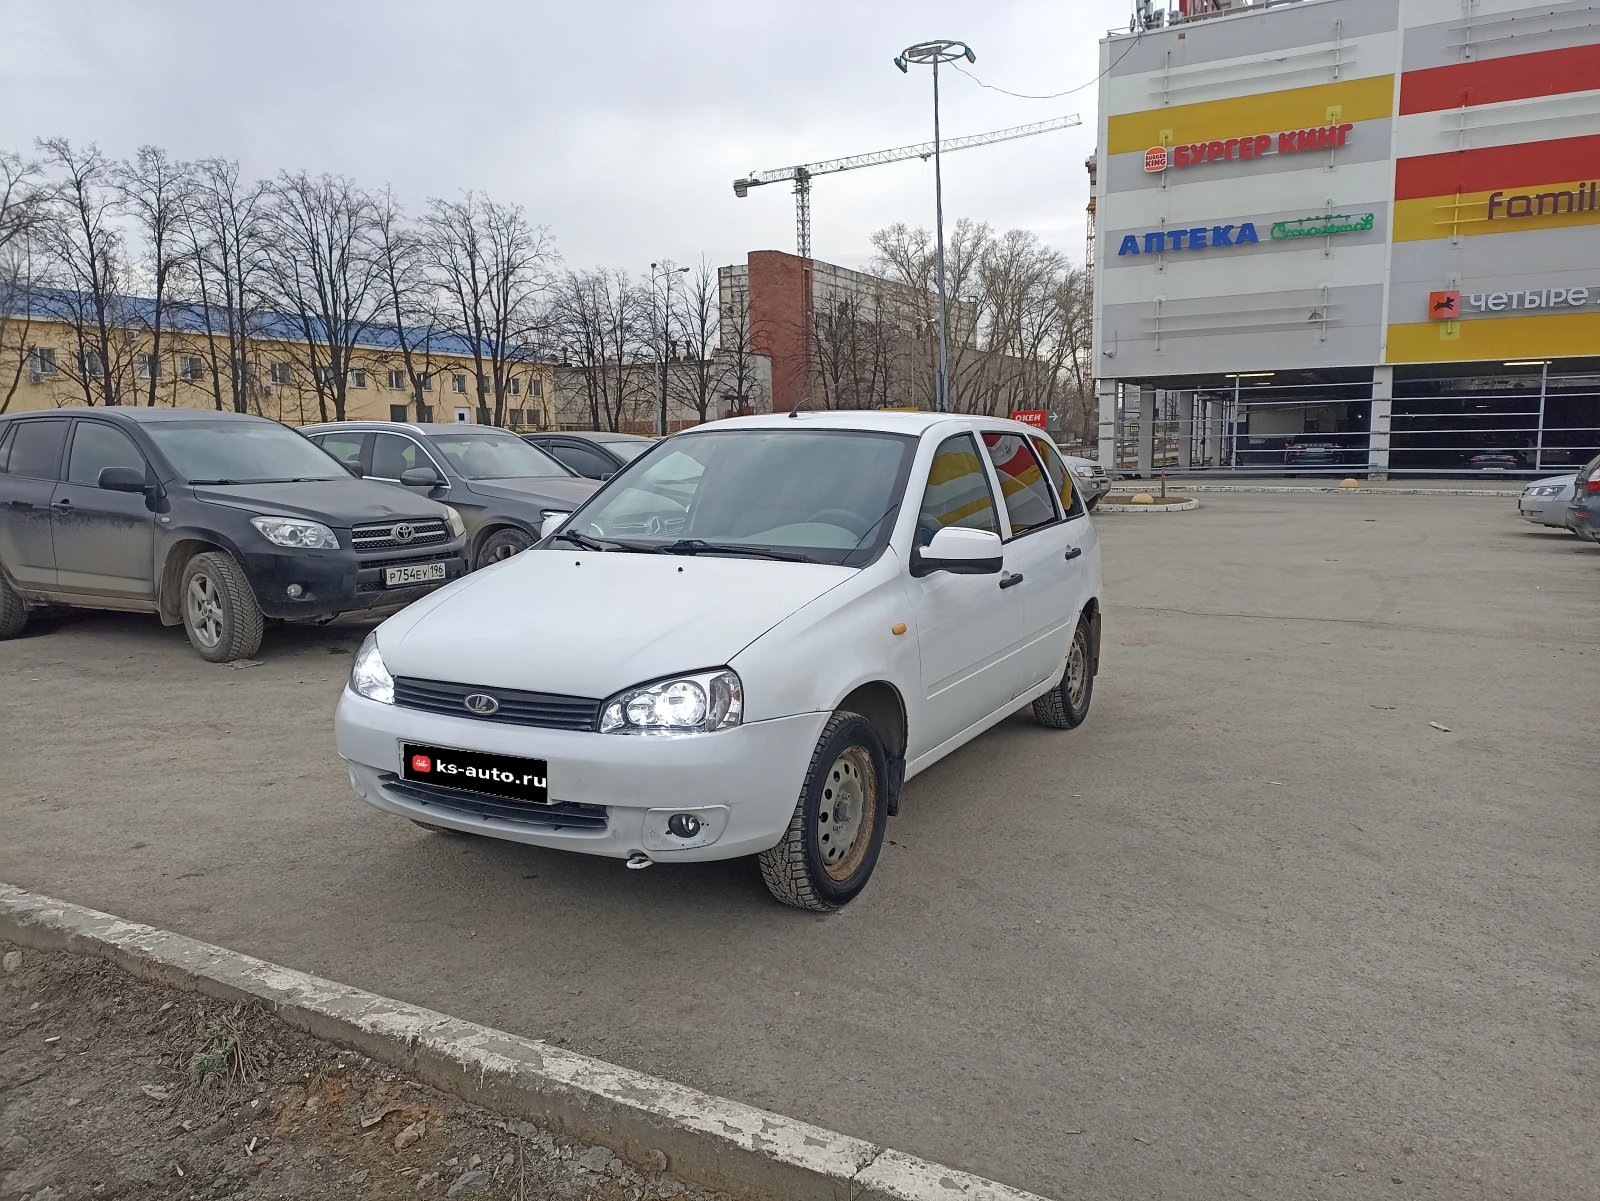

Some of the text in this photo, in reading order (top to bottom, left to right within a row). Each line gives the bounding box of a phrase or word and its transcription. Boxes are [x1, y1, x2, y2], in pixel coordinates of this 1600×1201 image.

[1174, 123, 1353, 168] БУРГЕР КИНГ
[1145, 158, 1166, 168] KING
[1118, 222, 1259, 256] АПТЕКА
[1470, 287, 1589, 312] четыре
[430, 564, 444, 575] 196
